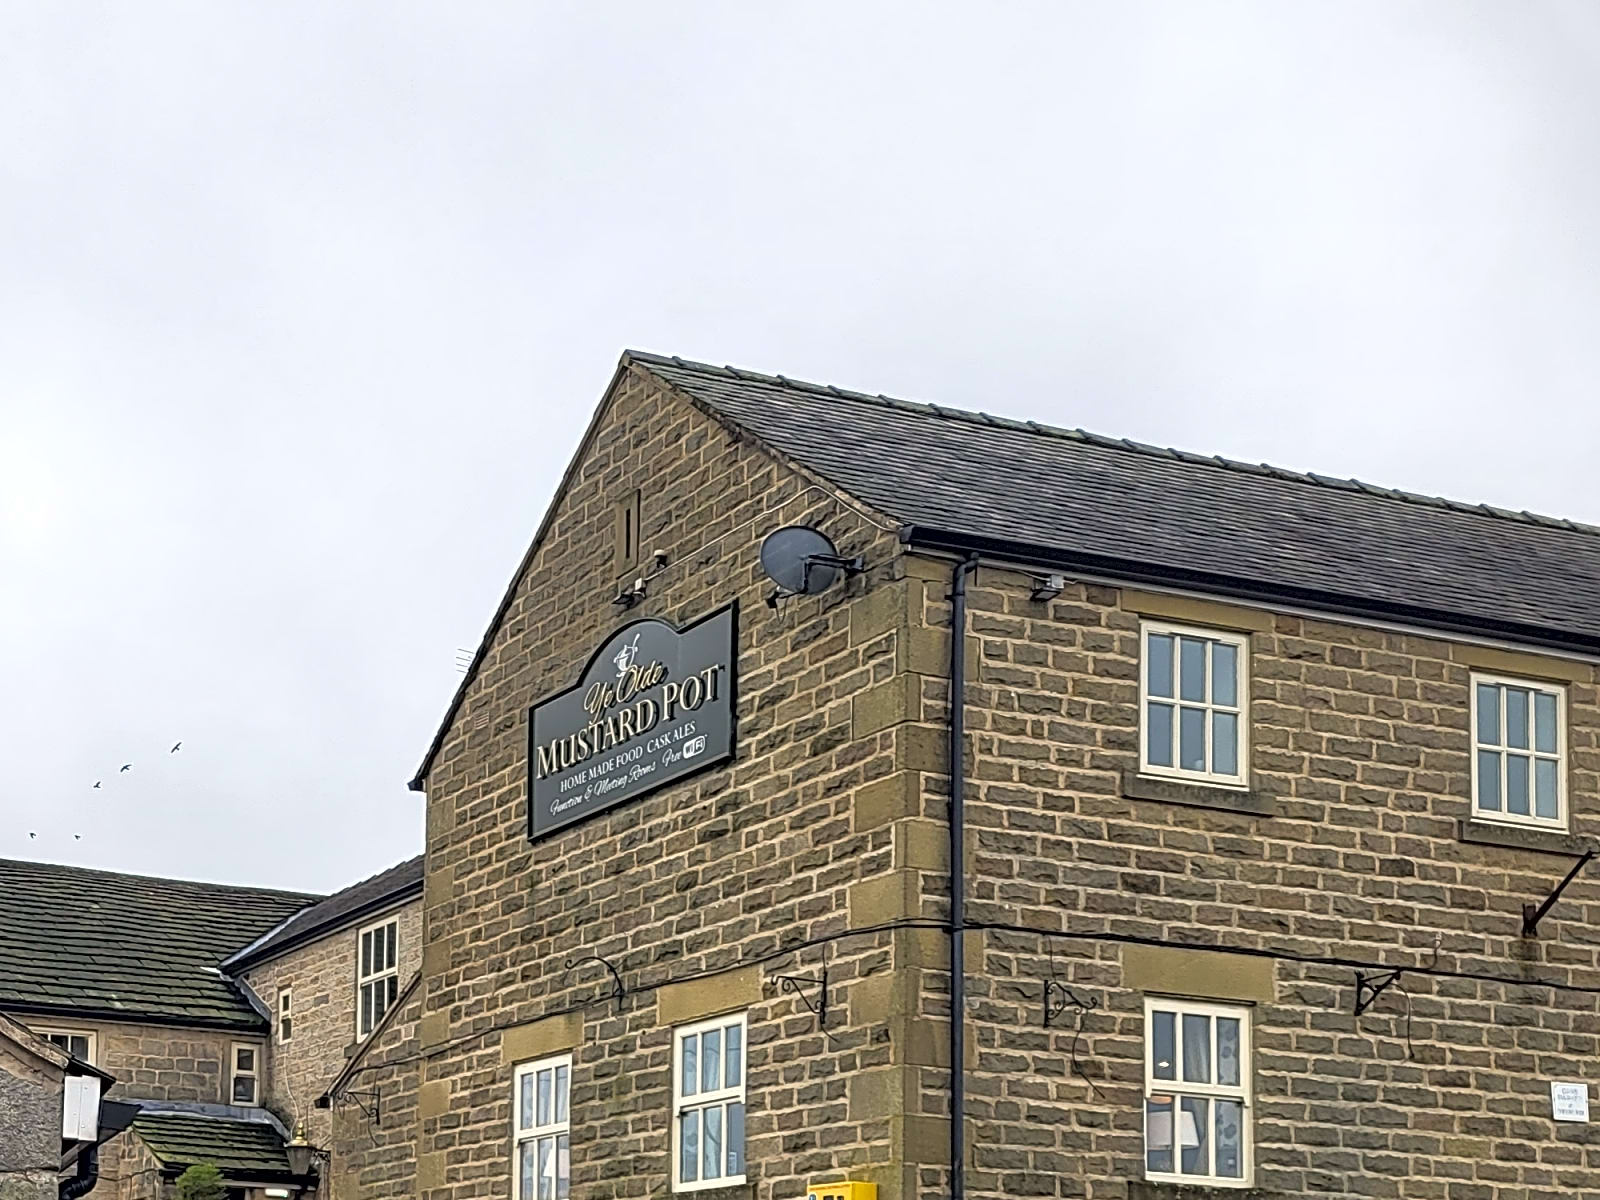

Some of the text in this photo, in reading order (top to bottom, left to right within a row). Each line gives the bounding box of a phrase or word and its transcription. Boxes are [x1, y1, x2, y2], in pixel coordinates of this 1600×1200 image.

[535, 664, 721, 780] MUSTARD POT
[584, 660, 664, 725] Ye Olde
[560, 720, 696, 793] HOME MADE FOOD CASK ALES
[584, 783, 593, 802] &
[661, 748, 682, 768] Free
